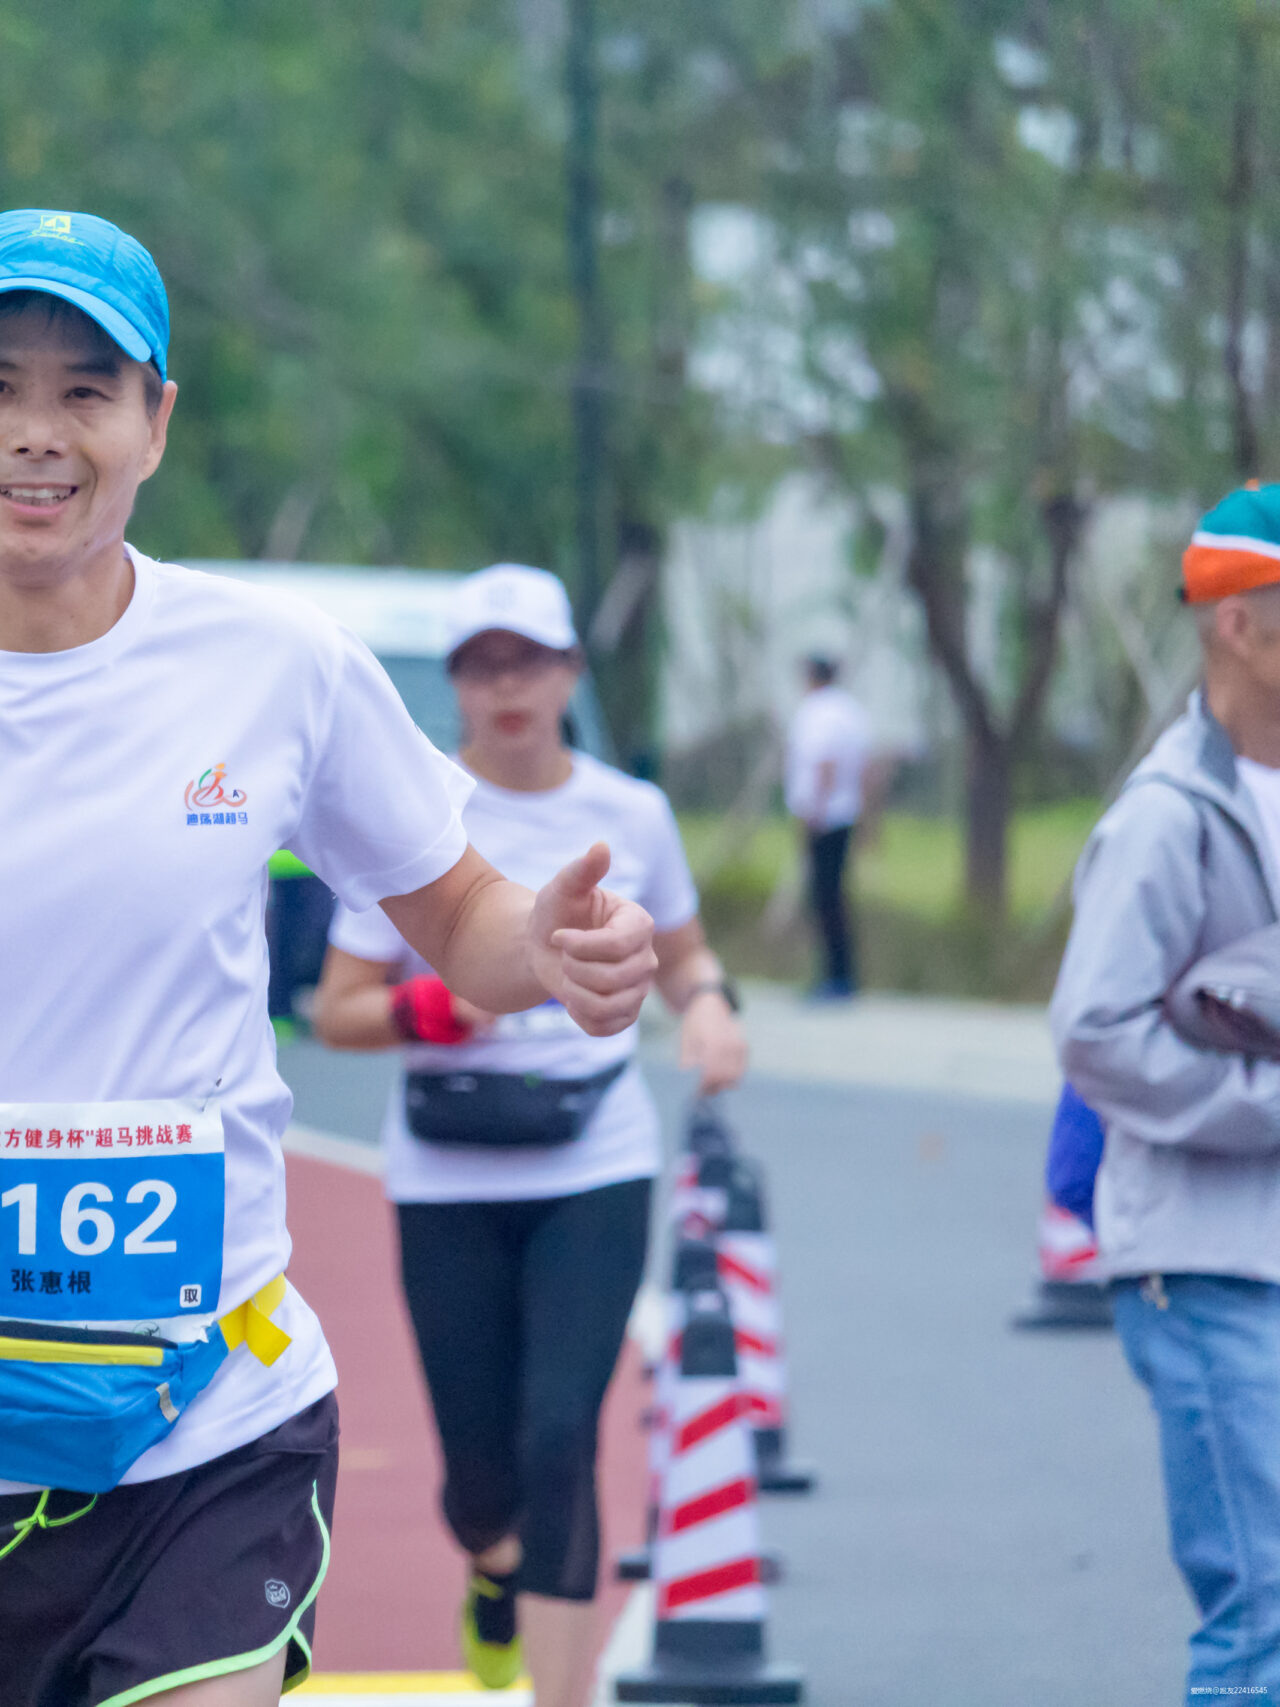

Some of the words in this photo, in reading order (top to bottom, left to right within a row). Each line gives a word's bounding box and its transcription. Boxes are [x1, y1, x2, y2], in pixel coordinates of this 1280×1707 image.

[10, 1269, 92, 1295] 张惠根
[183, 1288, 199, 1303] 取
